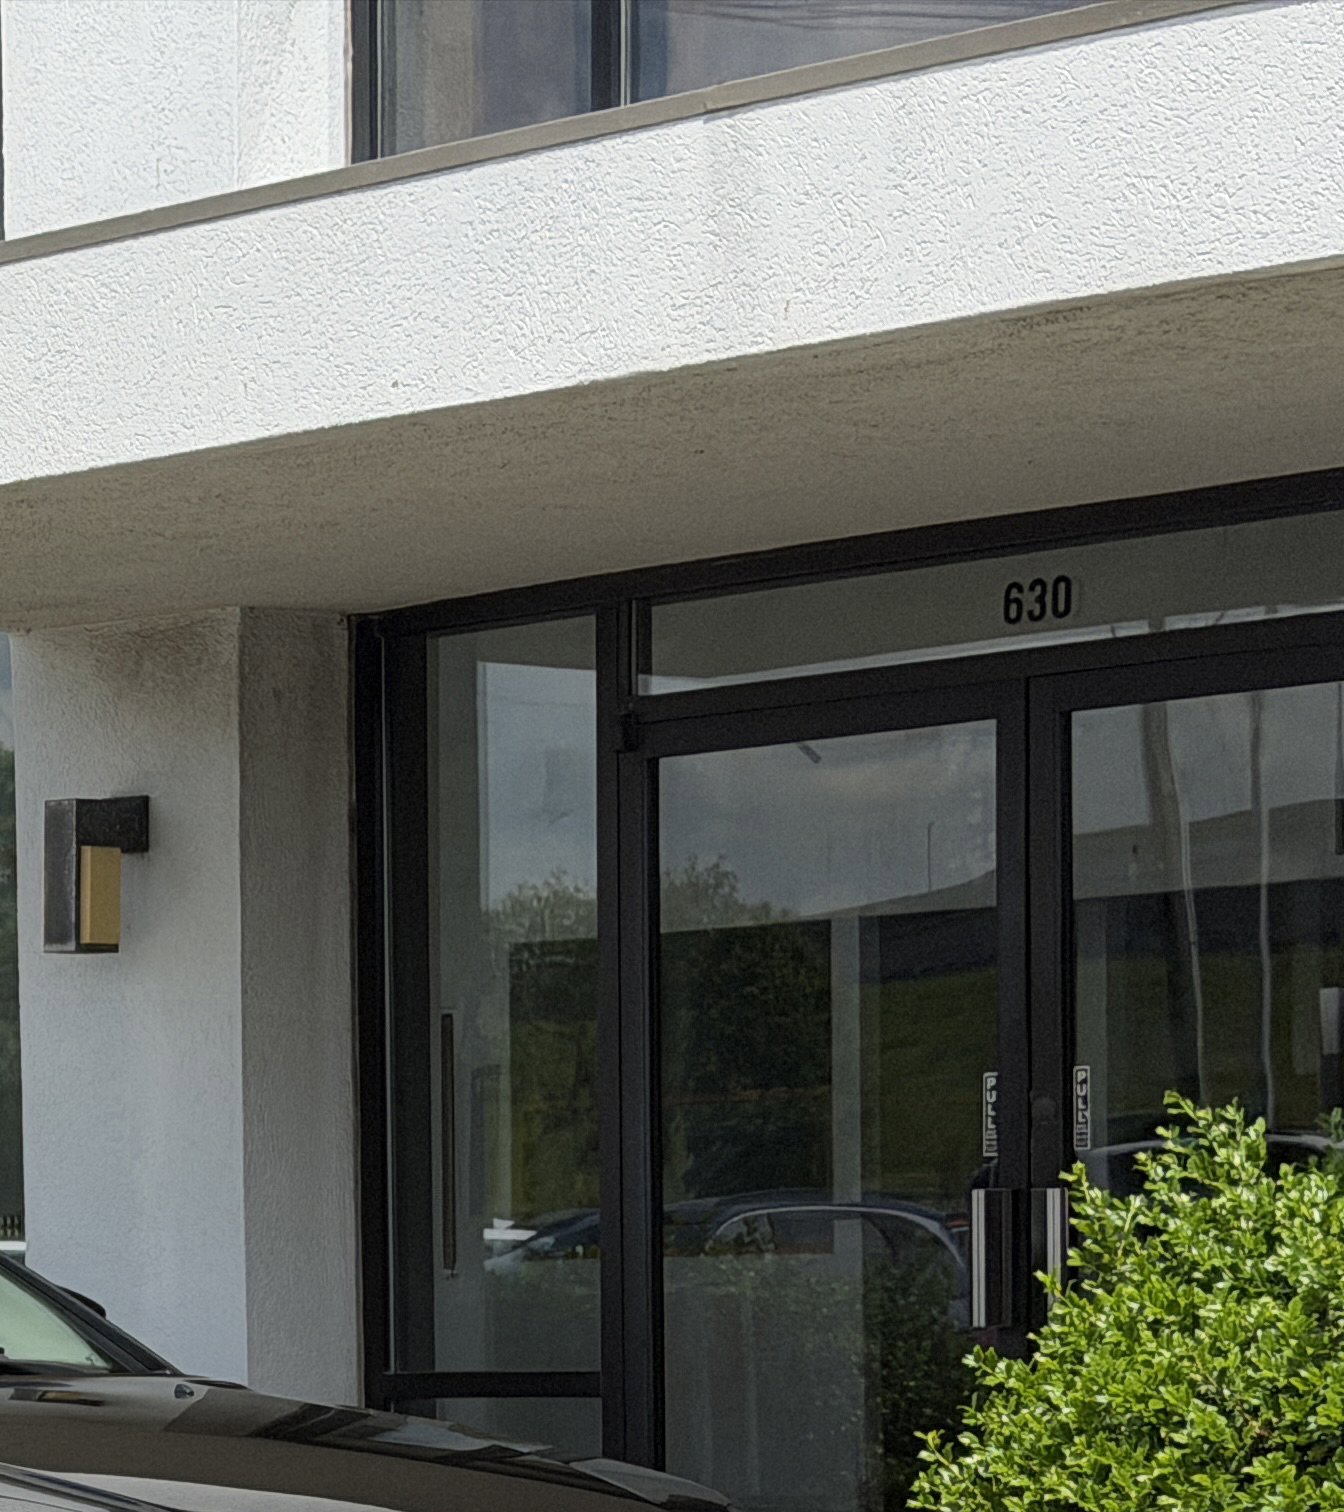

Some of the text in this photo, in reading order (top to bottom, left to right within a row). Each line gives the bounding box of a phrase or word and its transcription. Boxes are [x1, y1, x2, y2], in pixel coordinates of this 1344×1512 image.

[1003, 575, 1072, 624] 630
[986, 1077, 997, 1129] PULL
[1076, 1070, 1087, 1122] PULL
